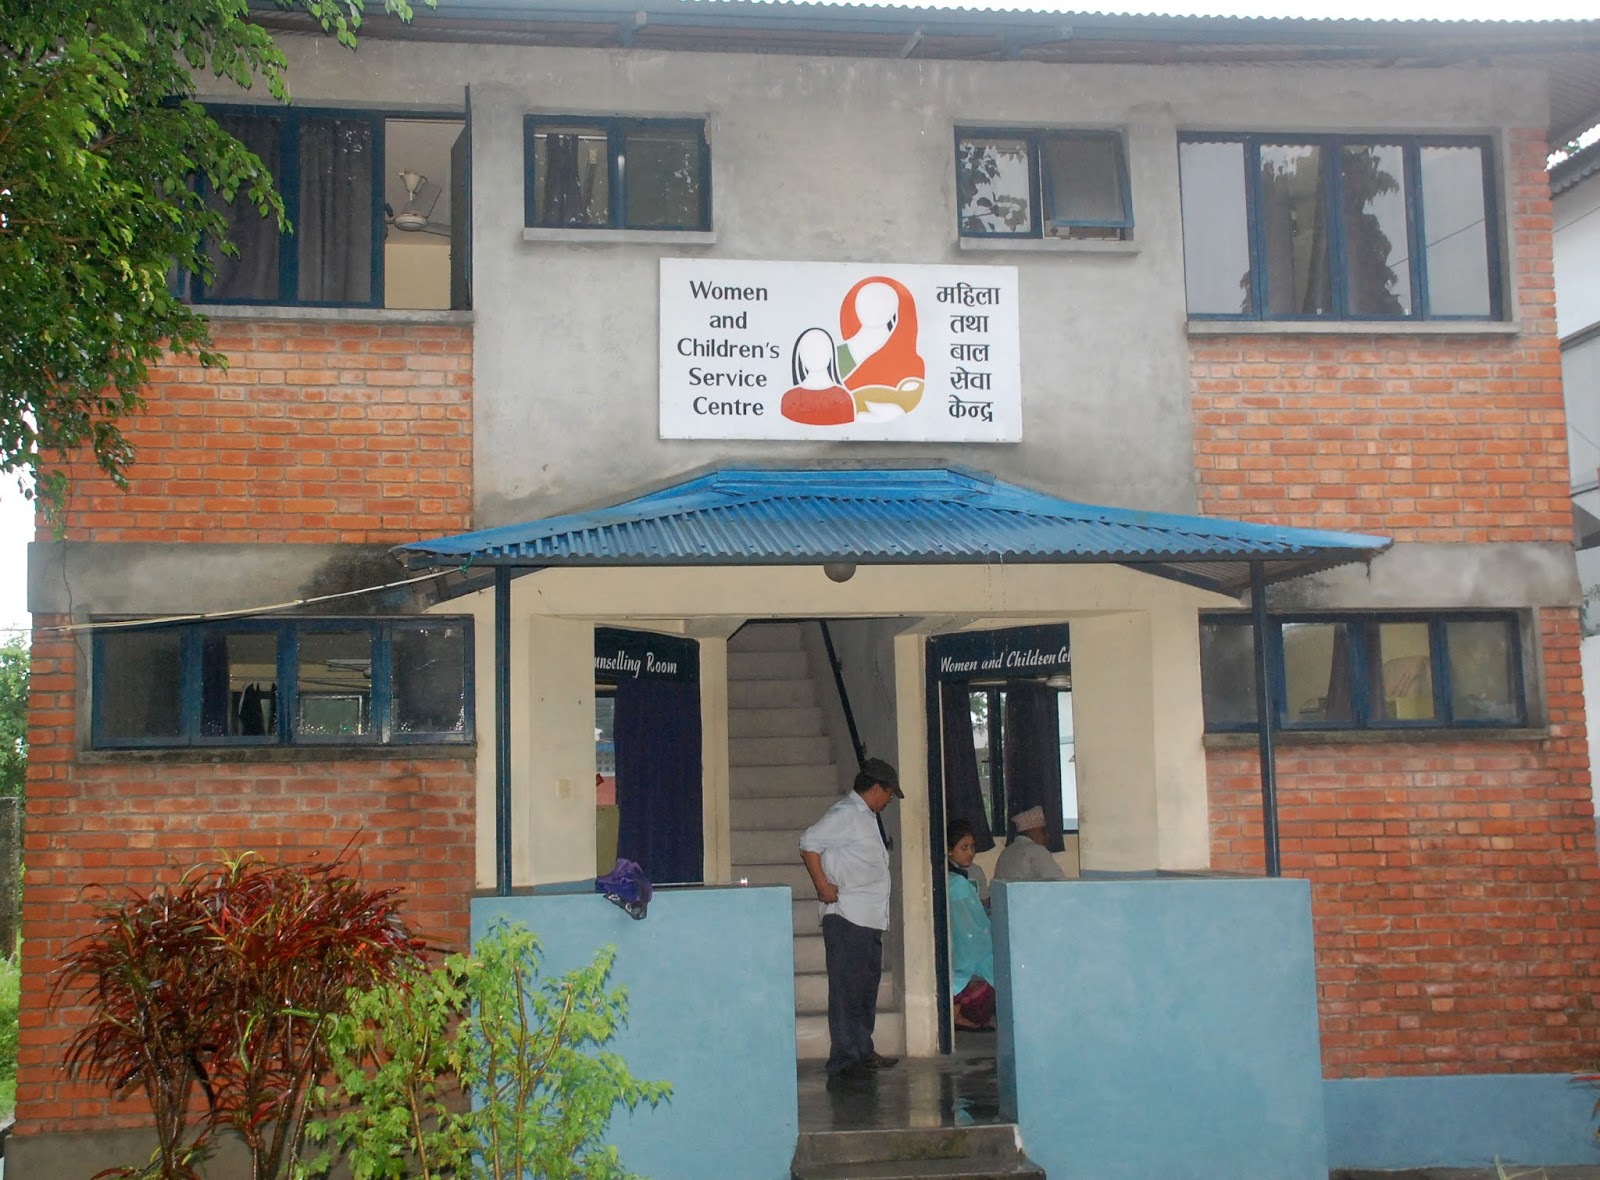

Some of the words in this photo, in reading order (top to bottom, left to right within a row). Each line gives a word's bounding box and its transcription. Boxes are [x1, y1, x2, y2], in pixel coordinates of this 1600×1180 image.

[689, 280, 768, 302] Women
[935, 281, 1001, 307] महिला
[709, 311, 747, 329] and
[950, 315, 989, 334] तथा
[677, 337, 780, 359] Children's
[950, 343, 990, 362] बाल
[689, 367, 767, 388] Service
[950, 366, 992, 390] सेवा
[692, 396, 764, 416] Centre
[949, 394, 994, 423] केन्द्र
[646, 651, 677, 674] Room
[940, 656, 978, 672] Women
[981, 652, 1004, 669] and
[1006, 649, 1058, 668] Children
